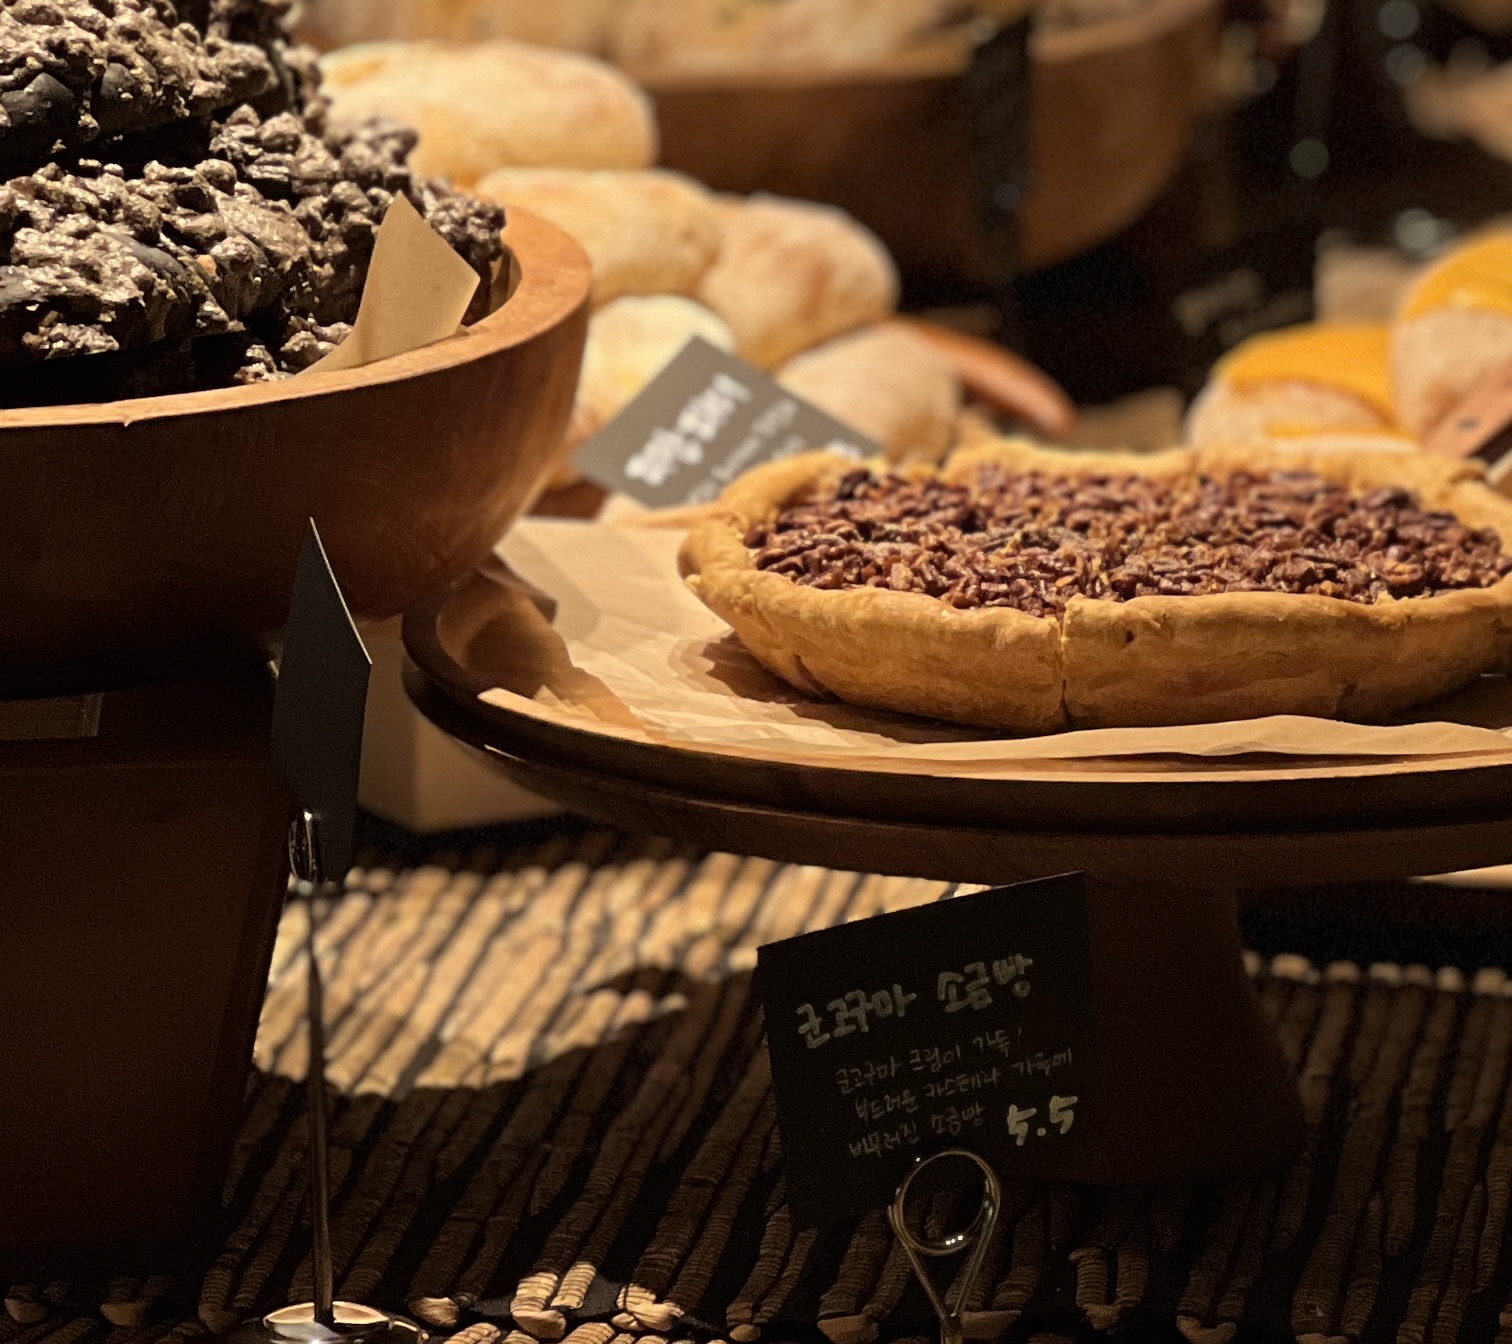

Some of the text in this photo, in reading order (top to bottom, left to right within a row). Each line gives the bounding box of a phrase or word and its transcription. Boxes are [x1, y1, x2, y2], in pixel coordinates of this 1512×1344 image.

[795, 953, 1033, 1049] 군고구마 소금빵
[835, 1055, 899, 1095] 군고구마
[909, 1044, 961, 1073] 크림이
[855, 1092, 918, 1122] 부드러운
[932, 1101, 986, 1135] 소금빵
[1006, 1095, 1078, 1146] 5.5
